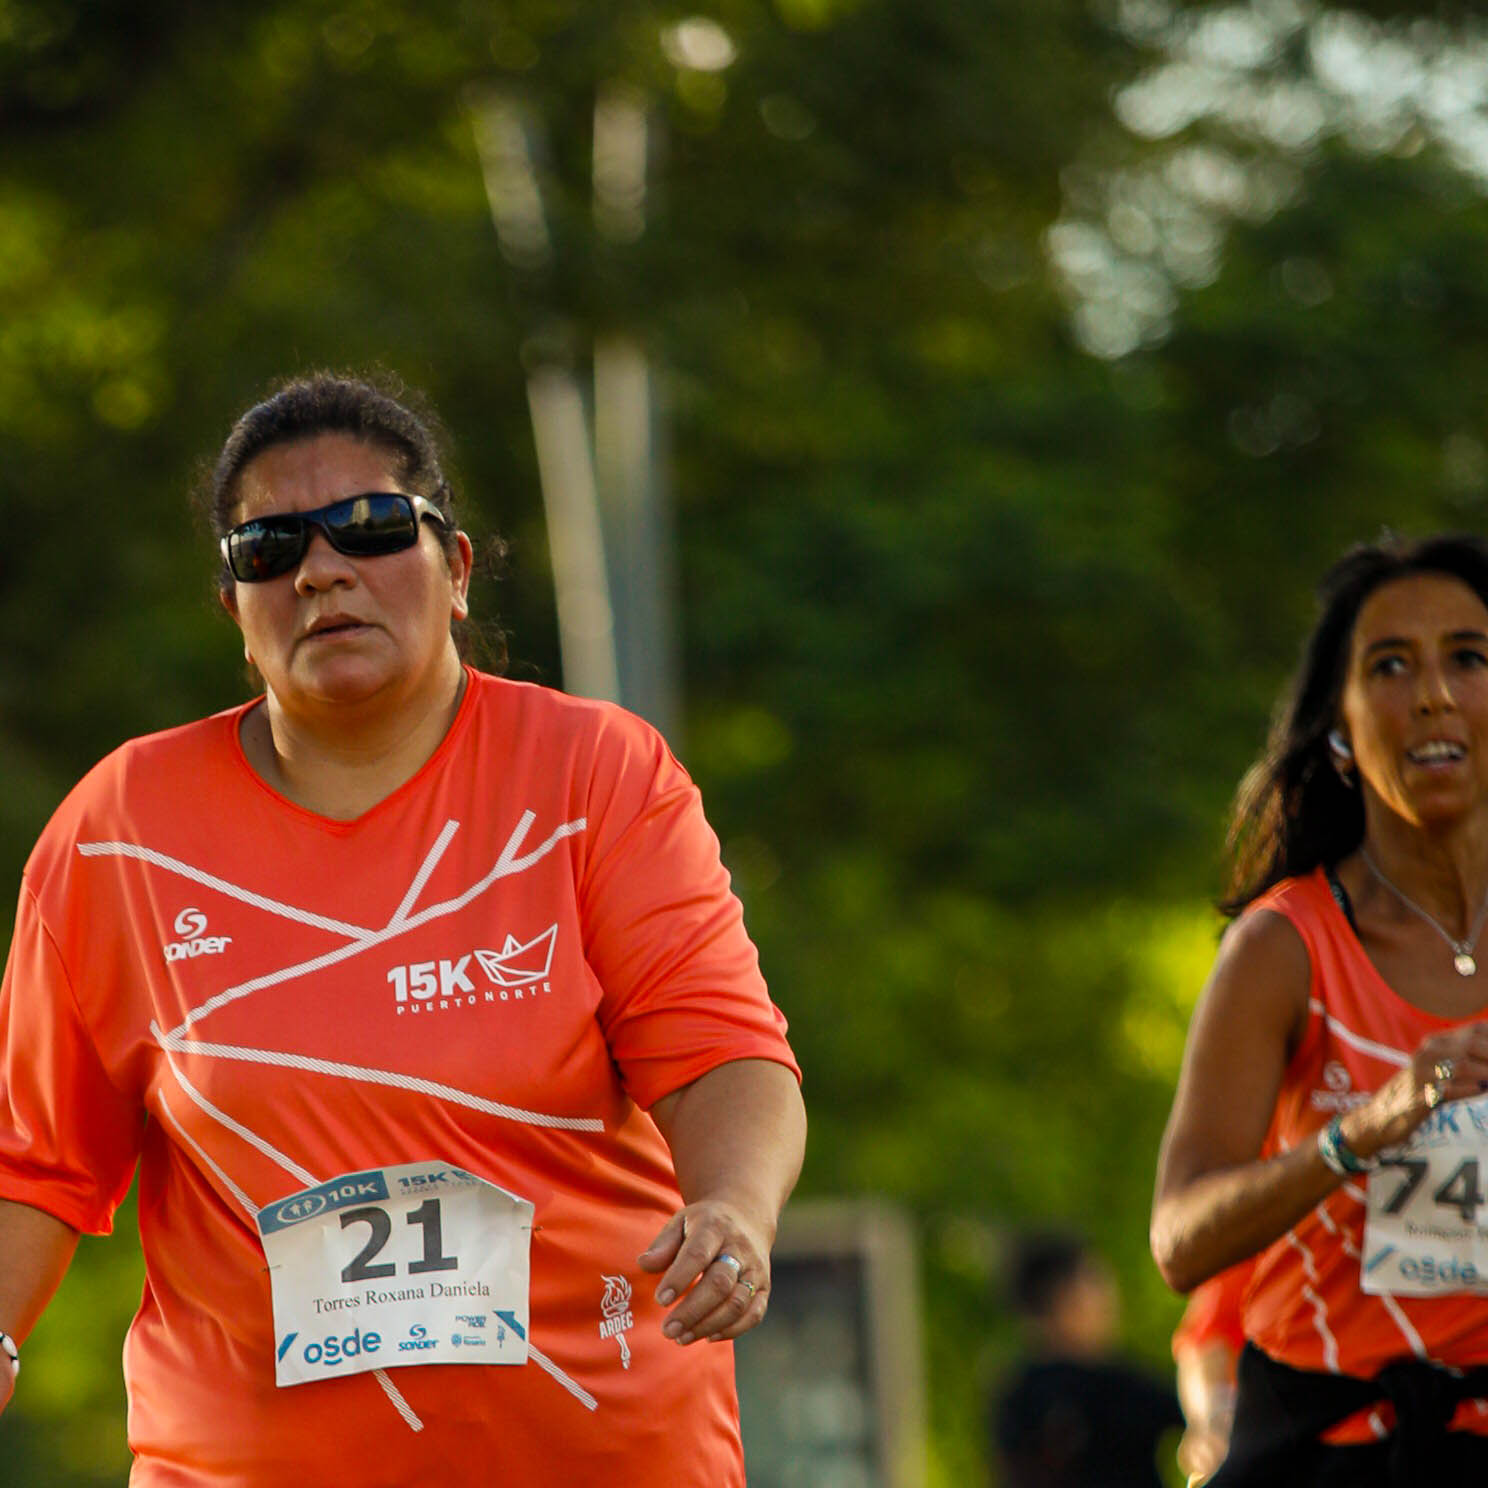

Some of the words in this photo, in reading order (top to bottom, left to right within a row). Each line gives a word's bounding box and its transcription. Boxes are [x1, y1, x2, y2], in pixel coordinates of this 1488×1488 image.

[387, 954, 475, 1002] 15K
[397, 995, 476, 1015] PUERTO
[485, 982, 551, 1002] NORTE
[328, 1182, 378, 1202] 10K
[338, 1198, 458, 1283] 21
[313, 1295, 361, 1314] Torres
[366, 1287, 425, 1305] Roxana
[430, 1281, 491, 1298] Daniela
[303, 1327, 382, 1365] osde
